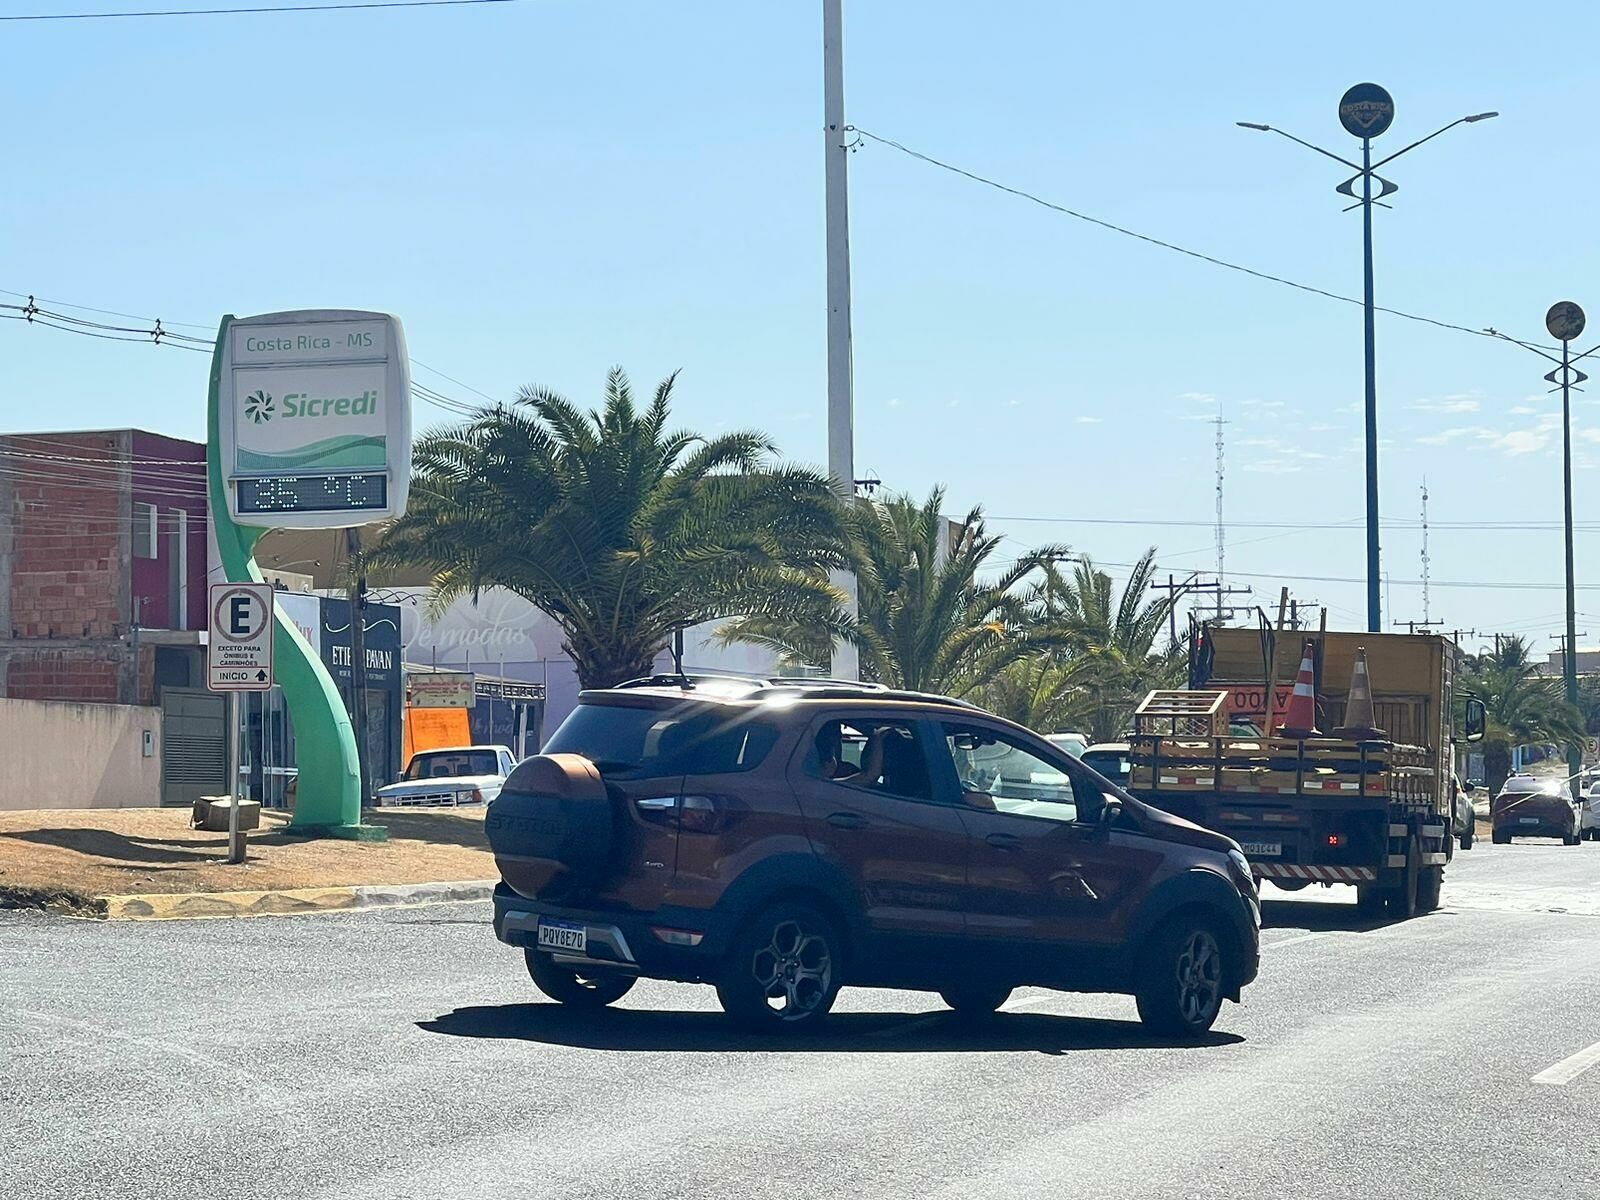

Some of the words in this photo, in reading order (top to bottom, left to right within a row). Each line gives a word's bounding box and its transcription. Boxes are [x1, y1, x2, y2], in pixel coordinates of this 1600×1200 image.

[247, 337, 291, 352] Costa
[298, 335, 330, 349] Rica
[347, 332, 373, 347] MS
[282, 391, 377, 417] Sicredi
[255, 477, 297, 509] 35
[230, 597, 251, 634] E
[439, 611, 529, 646] modas
[366, 648, 392, 670] PAVAN
[543, 927, 583, 948] PQY8E70
